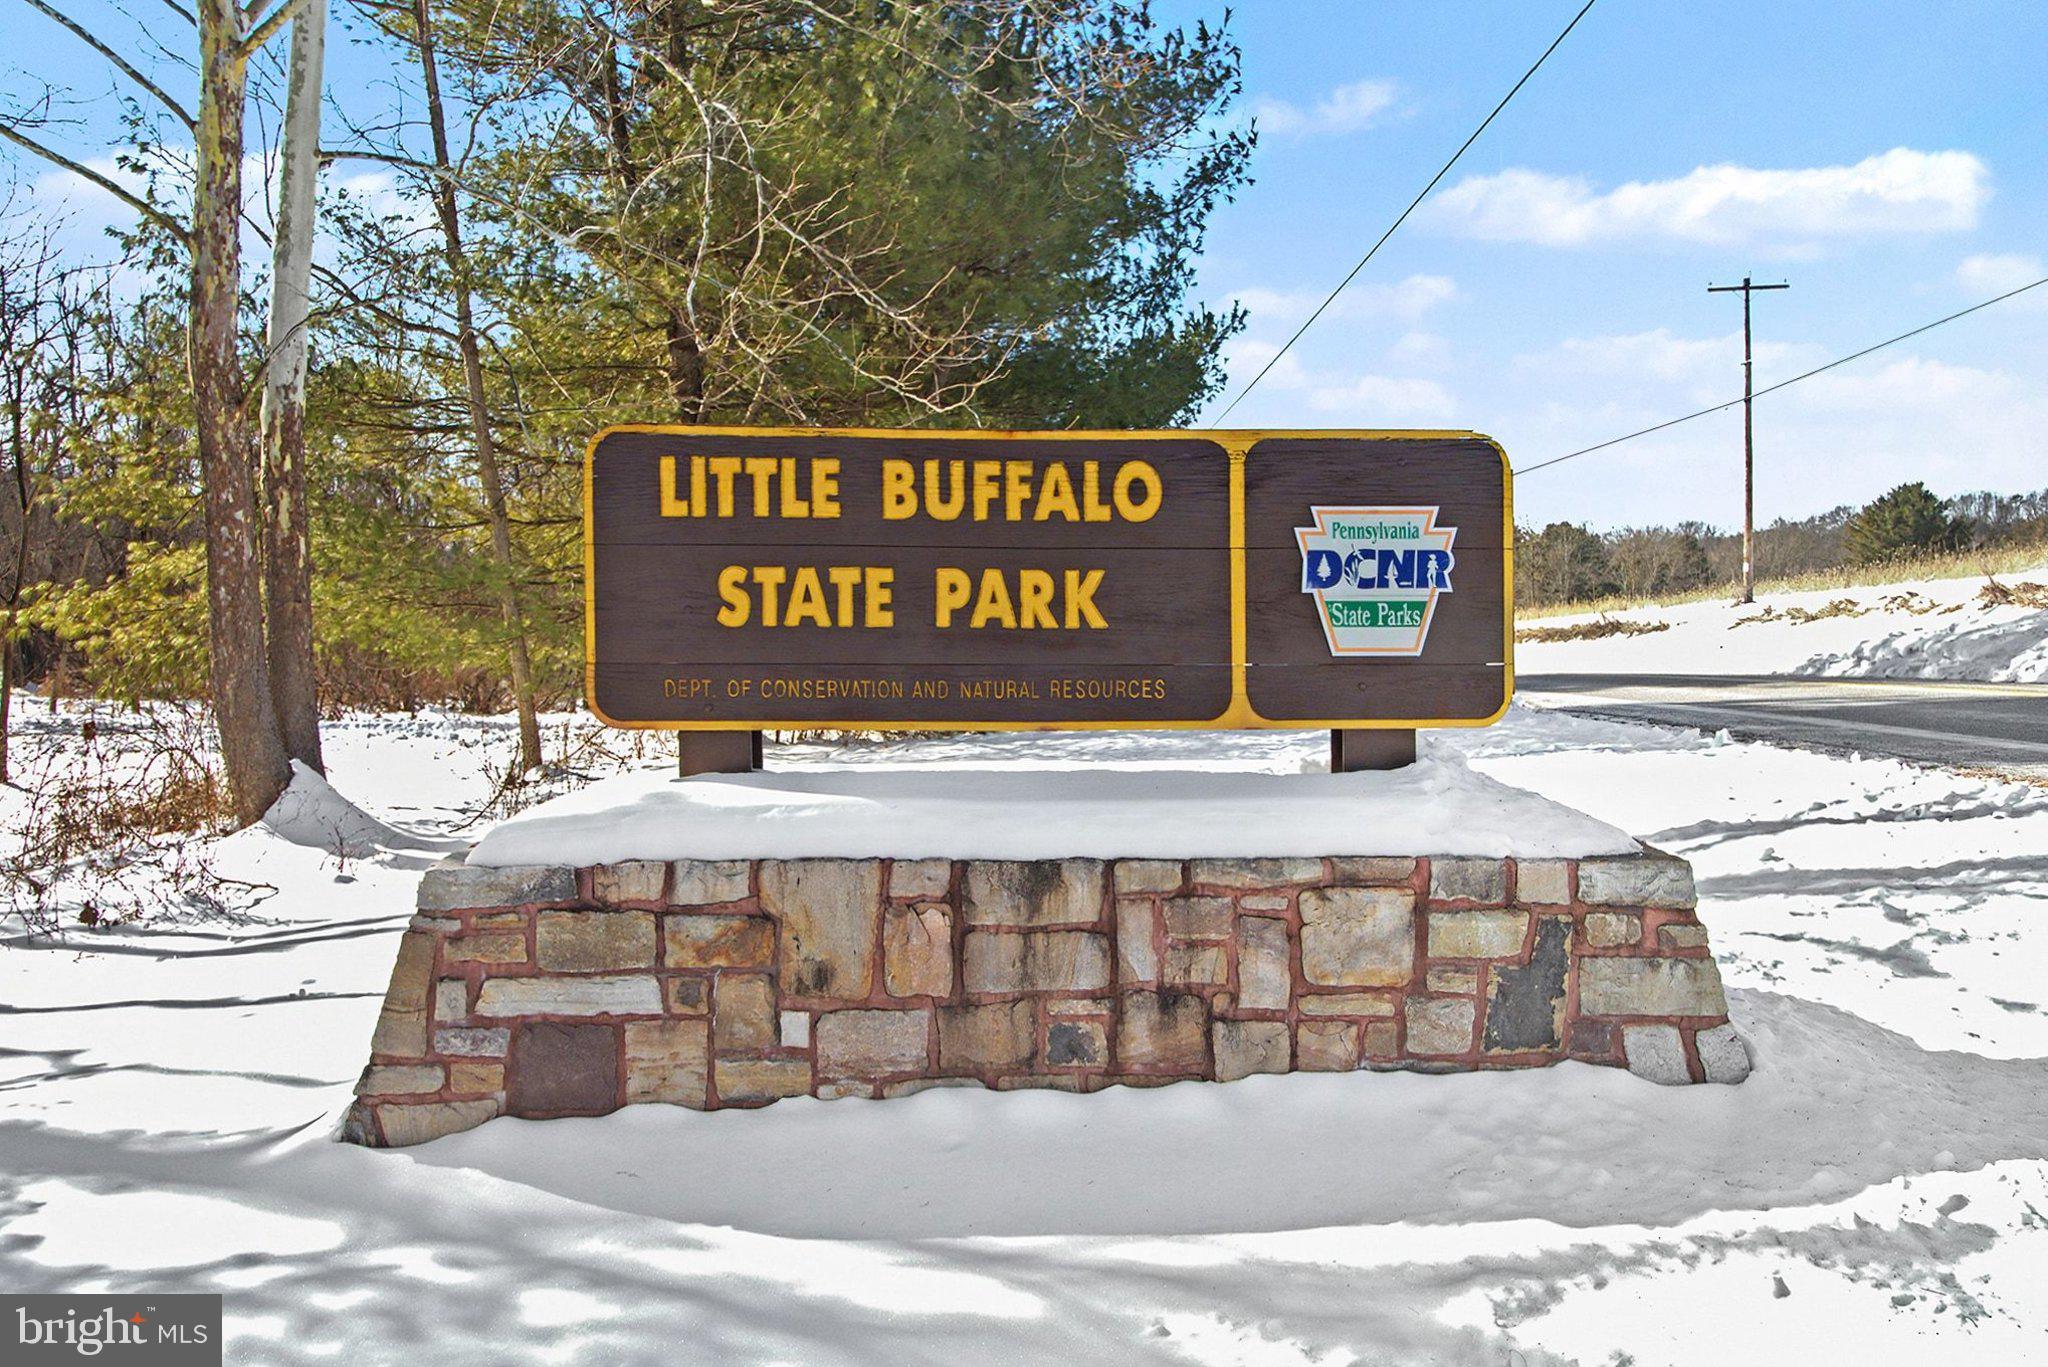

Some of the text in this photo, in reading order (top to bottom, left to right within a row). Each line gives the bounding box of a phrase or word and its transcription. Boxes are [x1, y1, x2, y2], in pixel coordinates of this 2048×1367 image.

[659, 455, 1163, 523] LITTLE BUFFALO
[1332, 521, 1420, 544] Pennsylvania
[1306, 549, 1452, 589] DCNR
[716, 565, 1109, 630] STATE PARK
[1332, 602, 1421, 627] State Parks
[664, 679, 1166, 701] DEPT. OF CONSERVATION AND NATURAL RESOURCES
